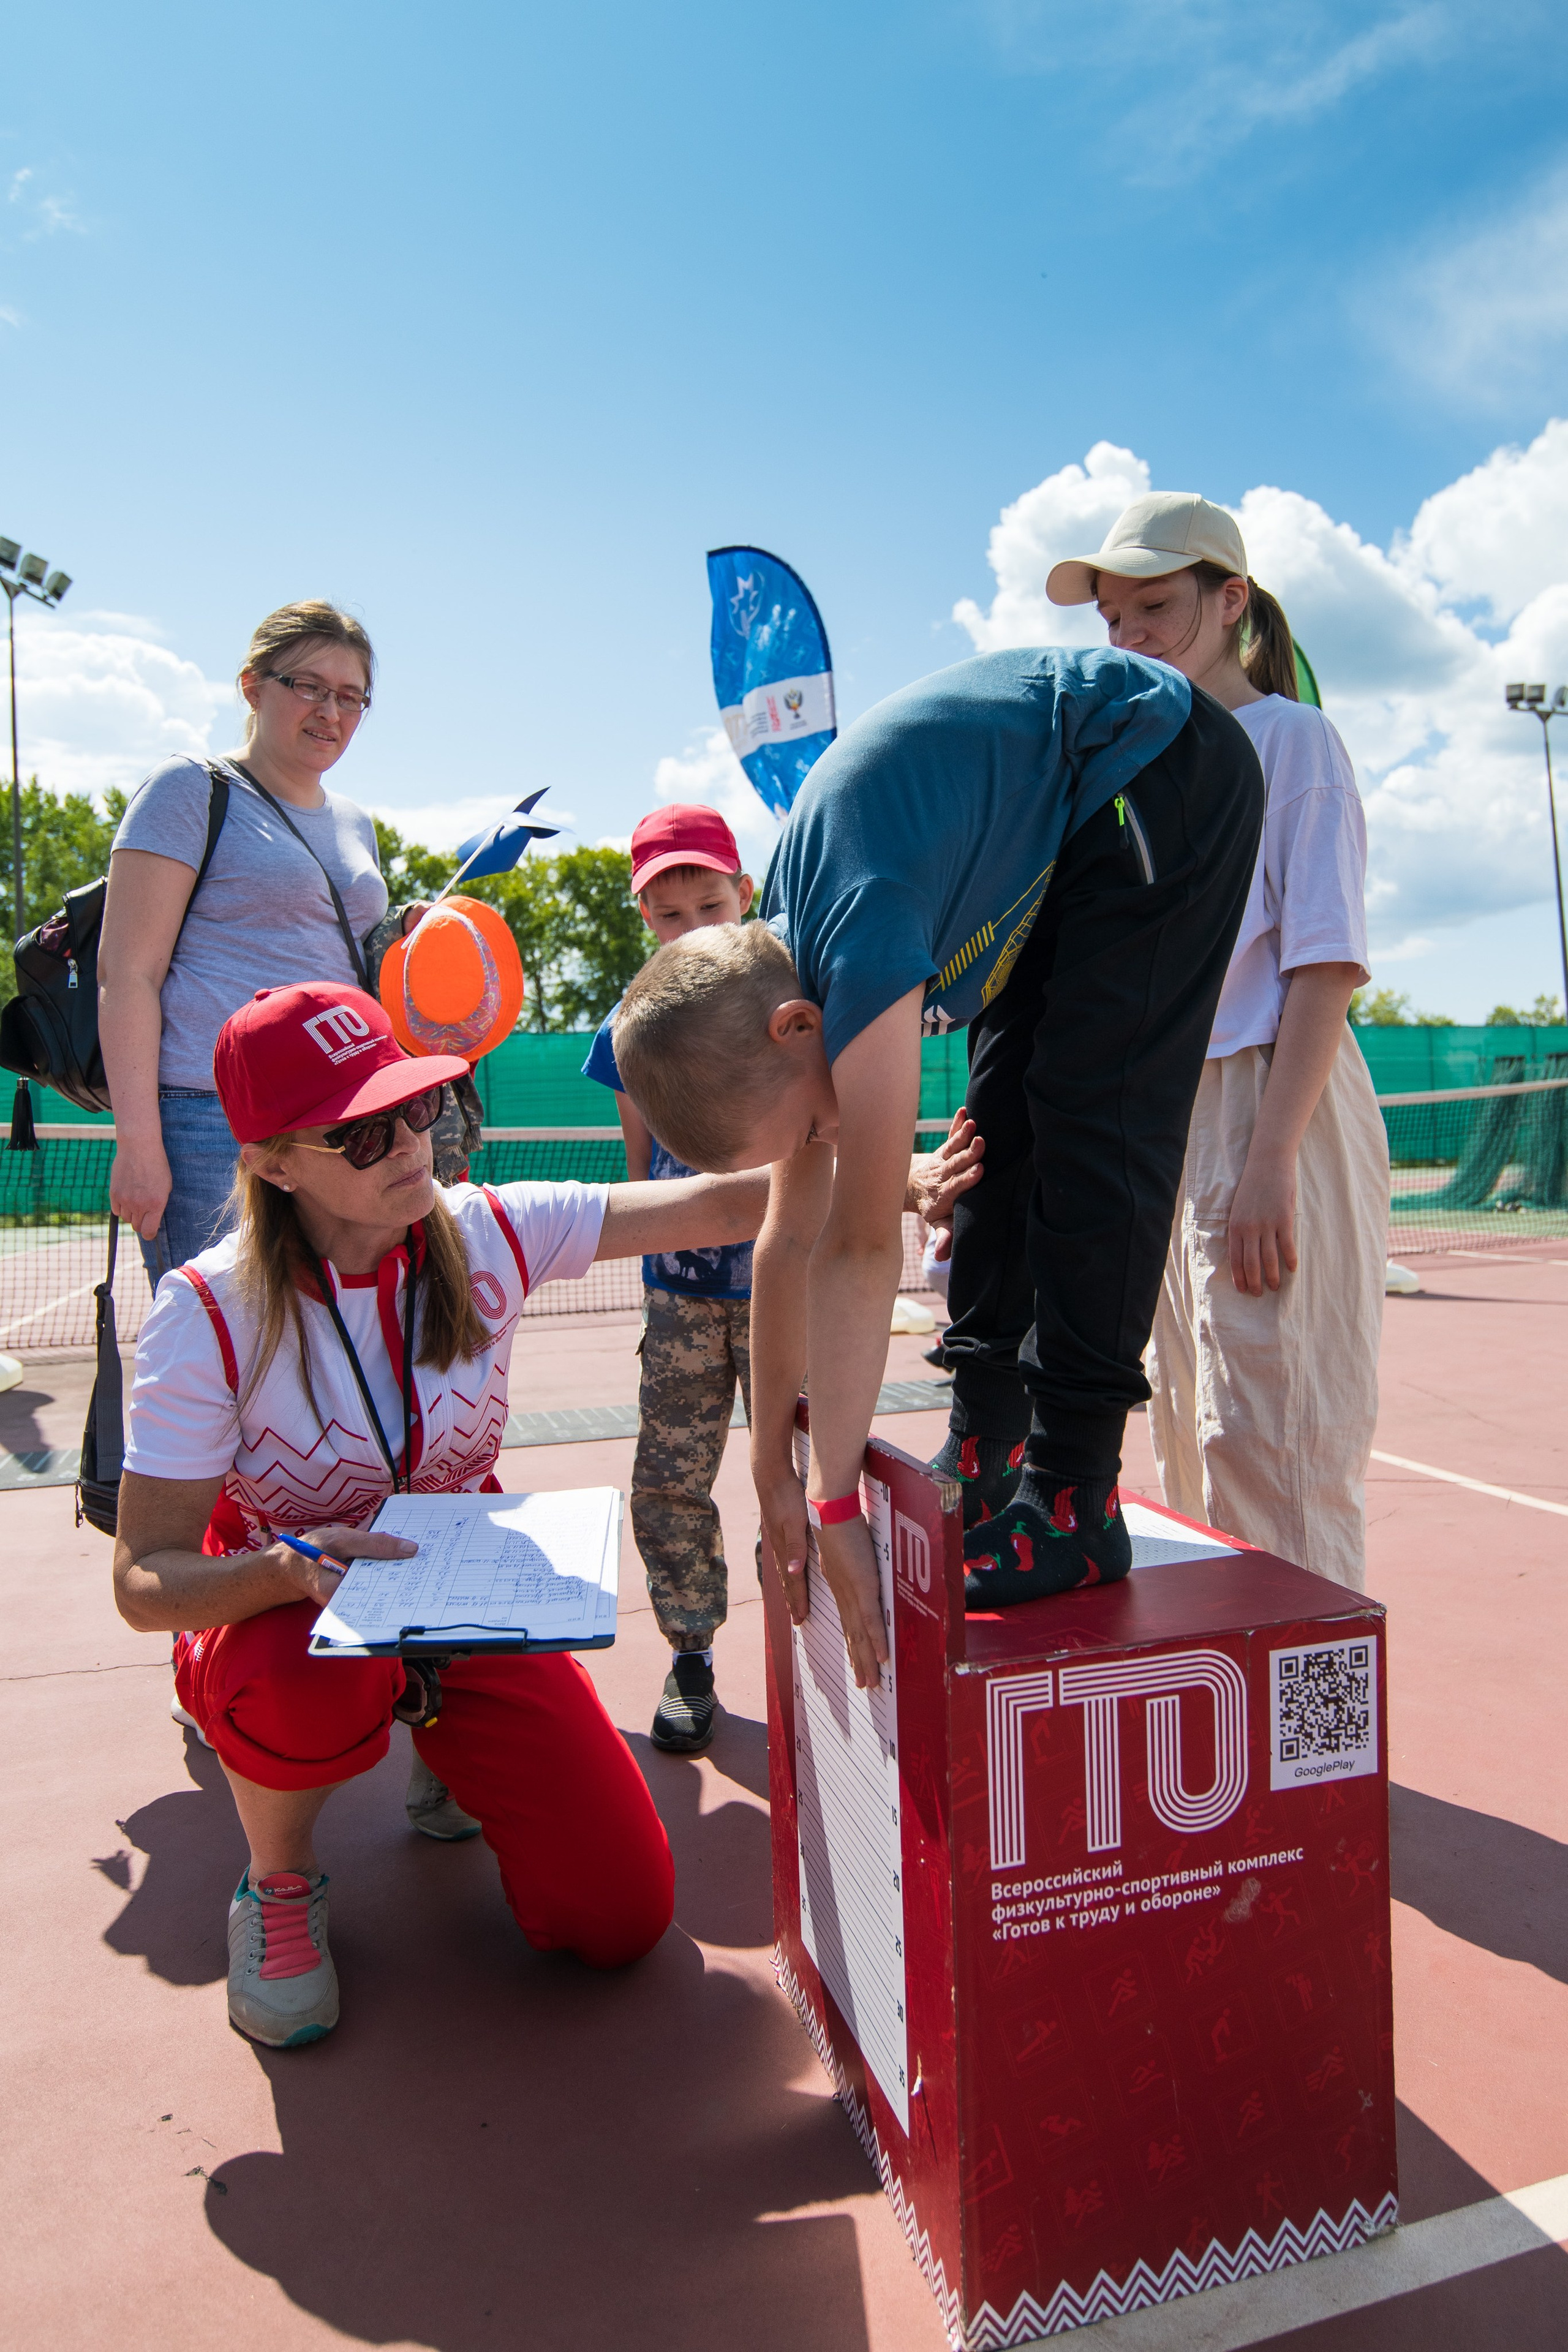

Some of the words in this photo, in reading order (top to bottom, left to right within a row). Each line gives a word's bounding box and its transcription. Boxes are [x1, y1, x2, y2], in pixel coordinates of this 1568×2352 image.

[302, 1005, 369, 1054] ГТО
[895, 1509, 930, 1593] ГТО
[888, 1674, 892, 1694] 5
[889, 1738, 895, 1761] 10
[986, 1649, 1248, 1871] ГТО
[1294, 1760, 1355, 1777] GooglePlay
[891, 1804, 897, 1826] 15
[893, 1869, 900, 1893] 20
[991, 1860, 1123, 1901] Всероссийский
[991, 1860, 1223, 1924] физкультурно-спортивный
[1227, 1847, 1304, 1874] комплекс
[992, 1918, 1050, 1940] «Готов
[1056, 1915, 1065, 1930] к
[1069, 1904, 1120, 1929] труду
[1125, 1901, 1135, 1915] и
[1141, 1885, 1221, 1912] обороне»
[895, 1934, 902, 1958] 25
[897, 1999, 903, 2024] 30
